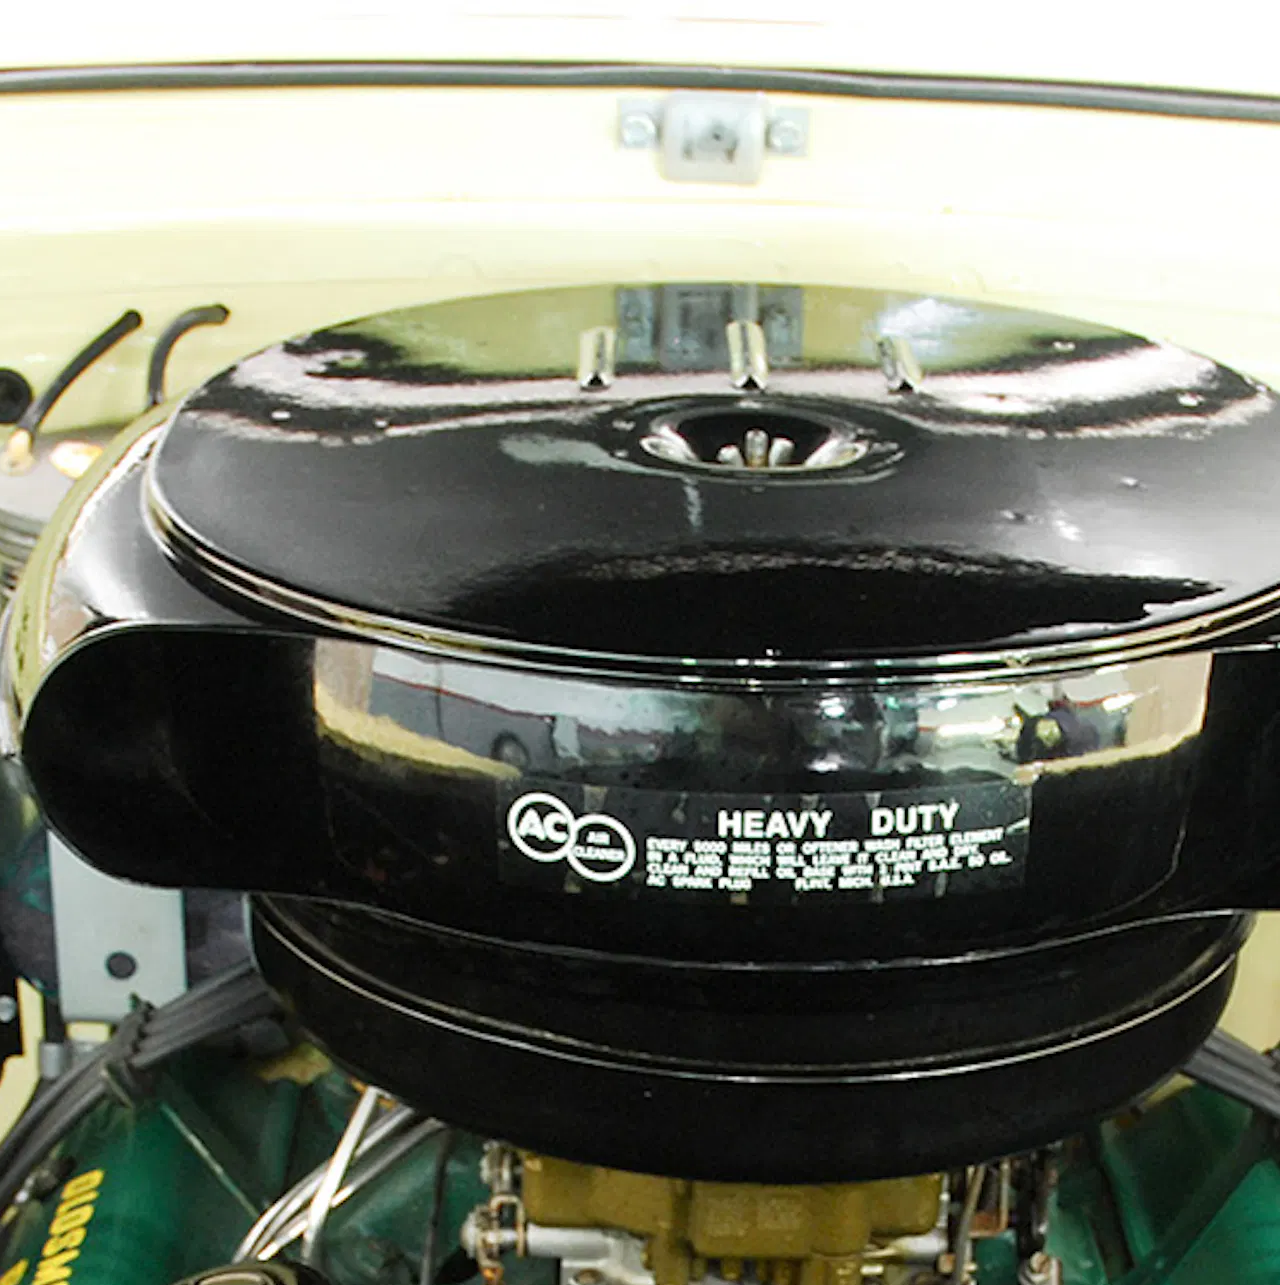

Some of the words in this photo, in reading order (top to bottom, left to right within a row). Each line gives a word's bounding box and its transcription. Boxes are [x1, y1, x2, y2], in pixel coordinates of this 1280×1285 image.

[517, 808, 569, 843] AC
[718, 810, 833, 838] HEAVY
[871, 802, 959, 836] DUTY
[586, 831, 611, 846] AIR
[646, 836, 689, 852] EVERY
[572, 845, 626, 862] CLEANER
[671, 875, 713, 888] SPARK
[718, 877, 752, 891] PLUG
